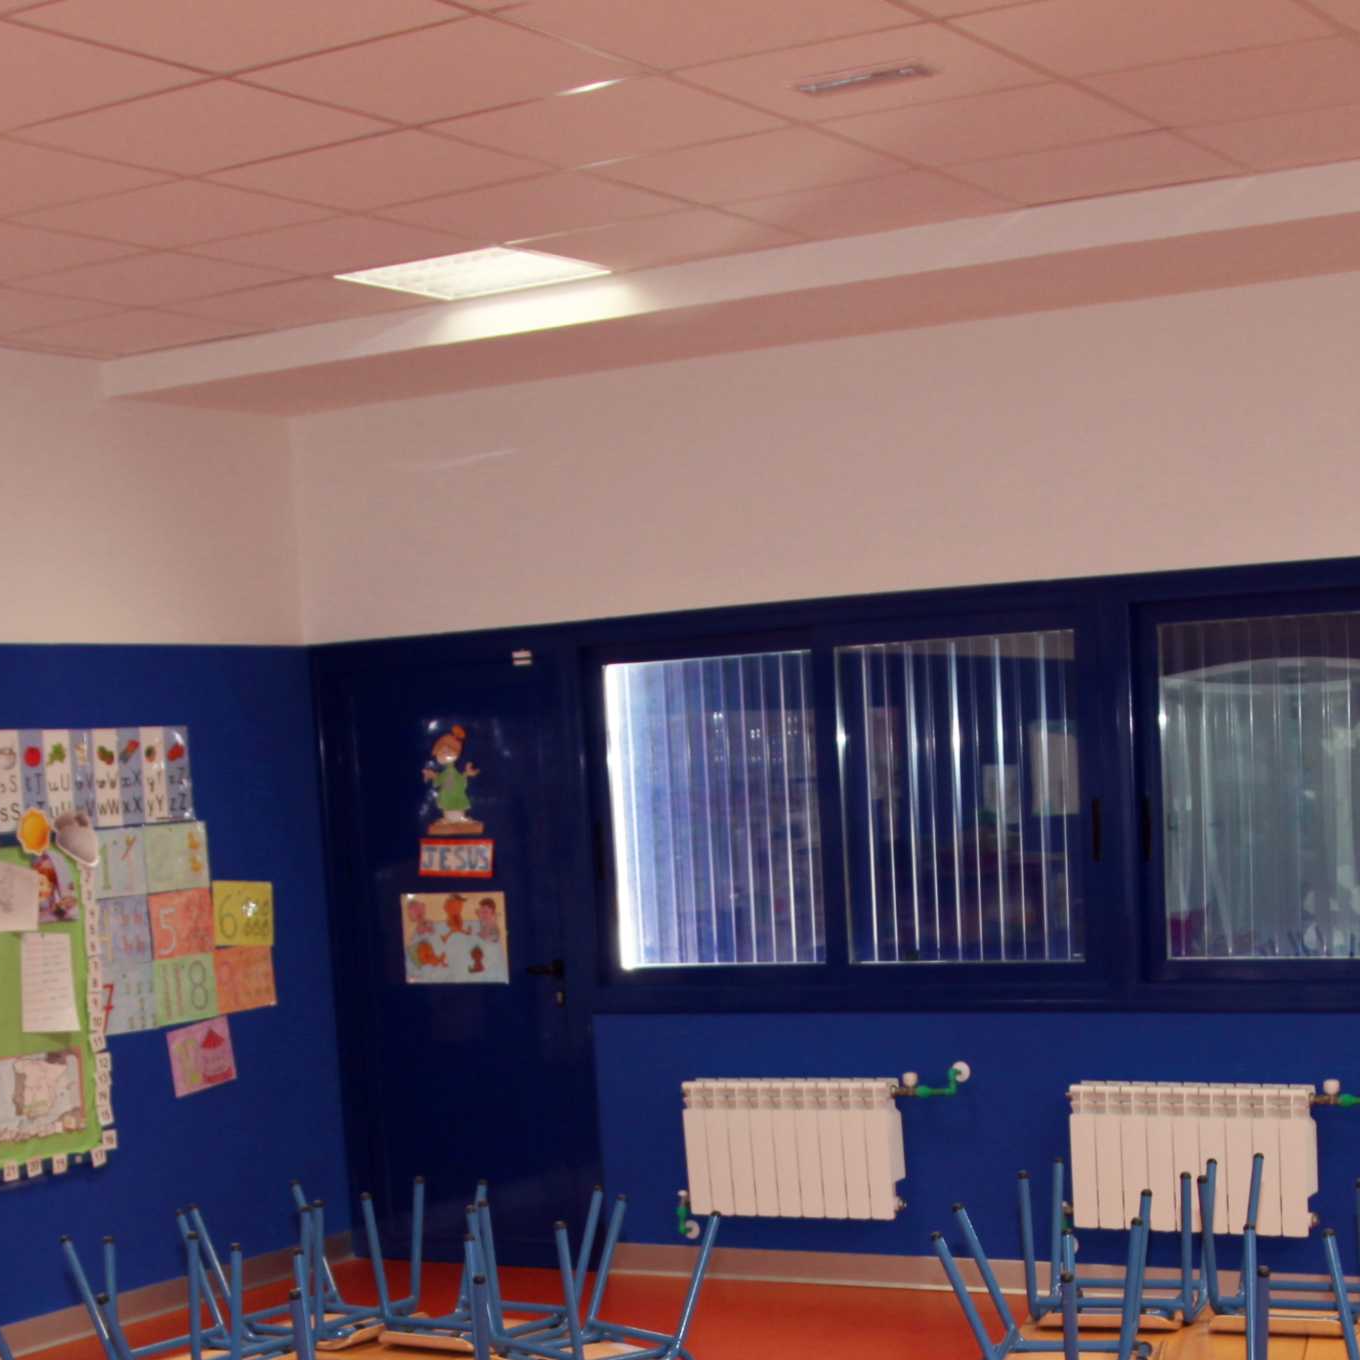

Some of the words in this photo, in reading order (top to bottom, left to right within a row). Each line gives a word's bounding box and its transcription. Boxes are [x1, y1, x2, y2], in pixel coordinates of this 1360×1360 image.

[422, 845, 490, 872] JESUS
[159, 906, 177, 954] 5
[219, 893, 238, 939] 6
[187, 959, 209, 1011] 8
